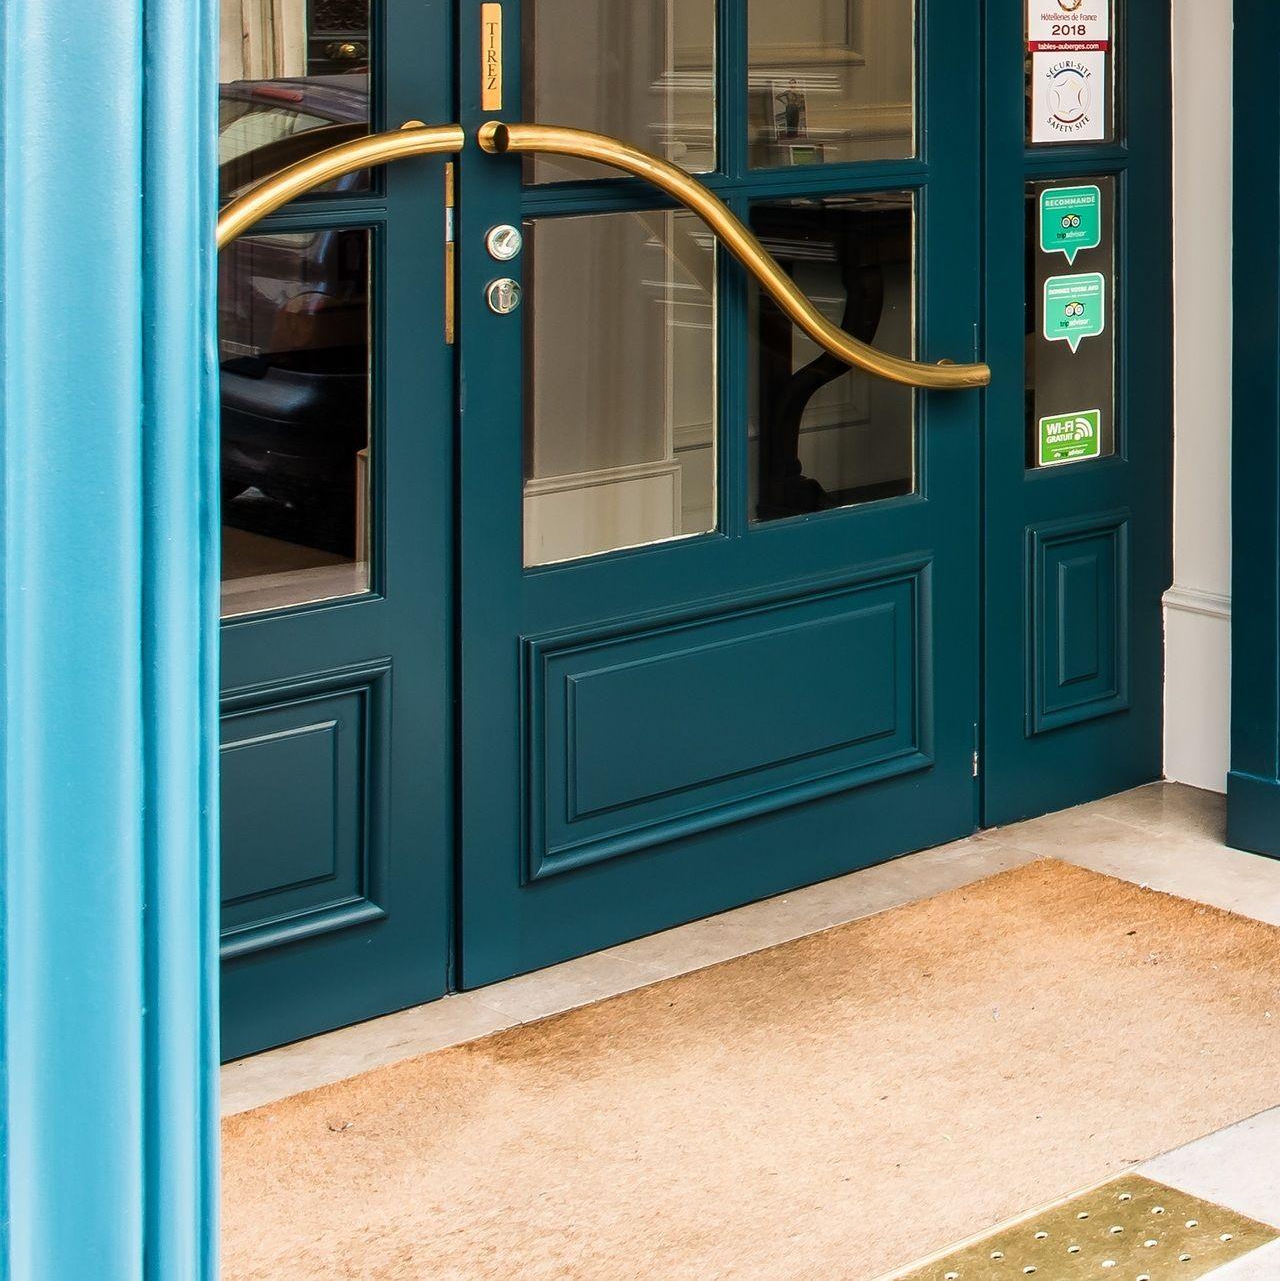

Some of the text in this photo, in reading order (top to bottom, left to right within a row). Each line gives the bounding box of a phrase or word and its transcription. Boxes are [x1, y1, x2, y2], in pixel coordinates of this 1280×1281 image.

[1071, 13, 1079, 21] de
[1079, 13, 1097, 21] France
[1052, 24, 1086, 36] 2018
[1038, 43, 1099, 51] tables-auberges.com
[486, 22, 498, 90] TIREZ
[1047, 115, 1090, 133] SAFETY SITE
[1046, 420, 1074, 436] WI-FI
[1046, 432, 1074, 444] GRATUIT
